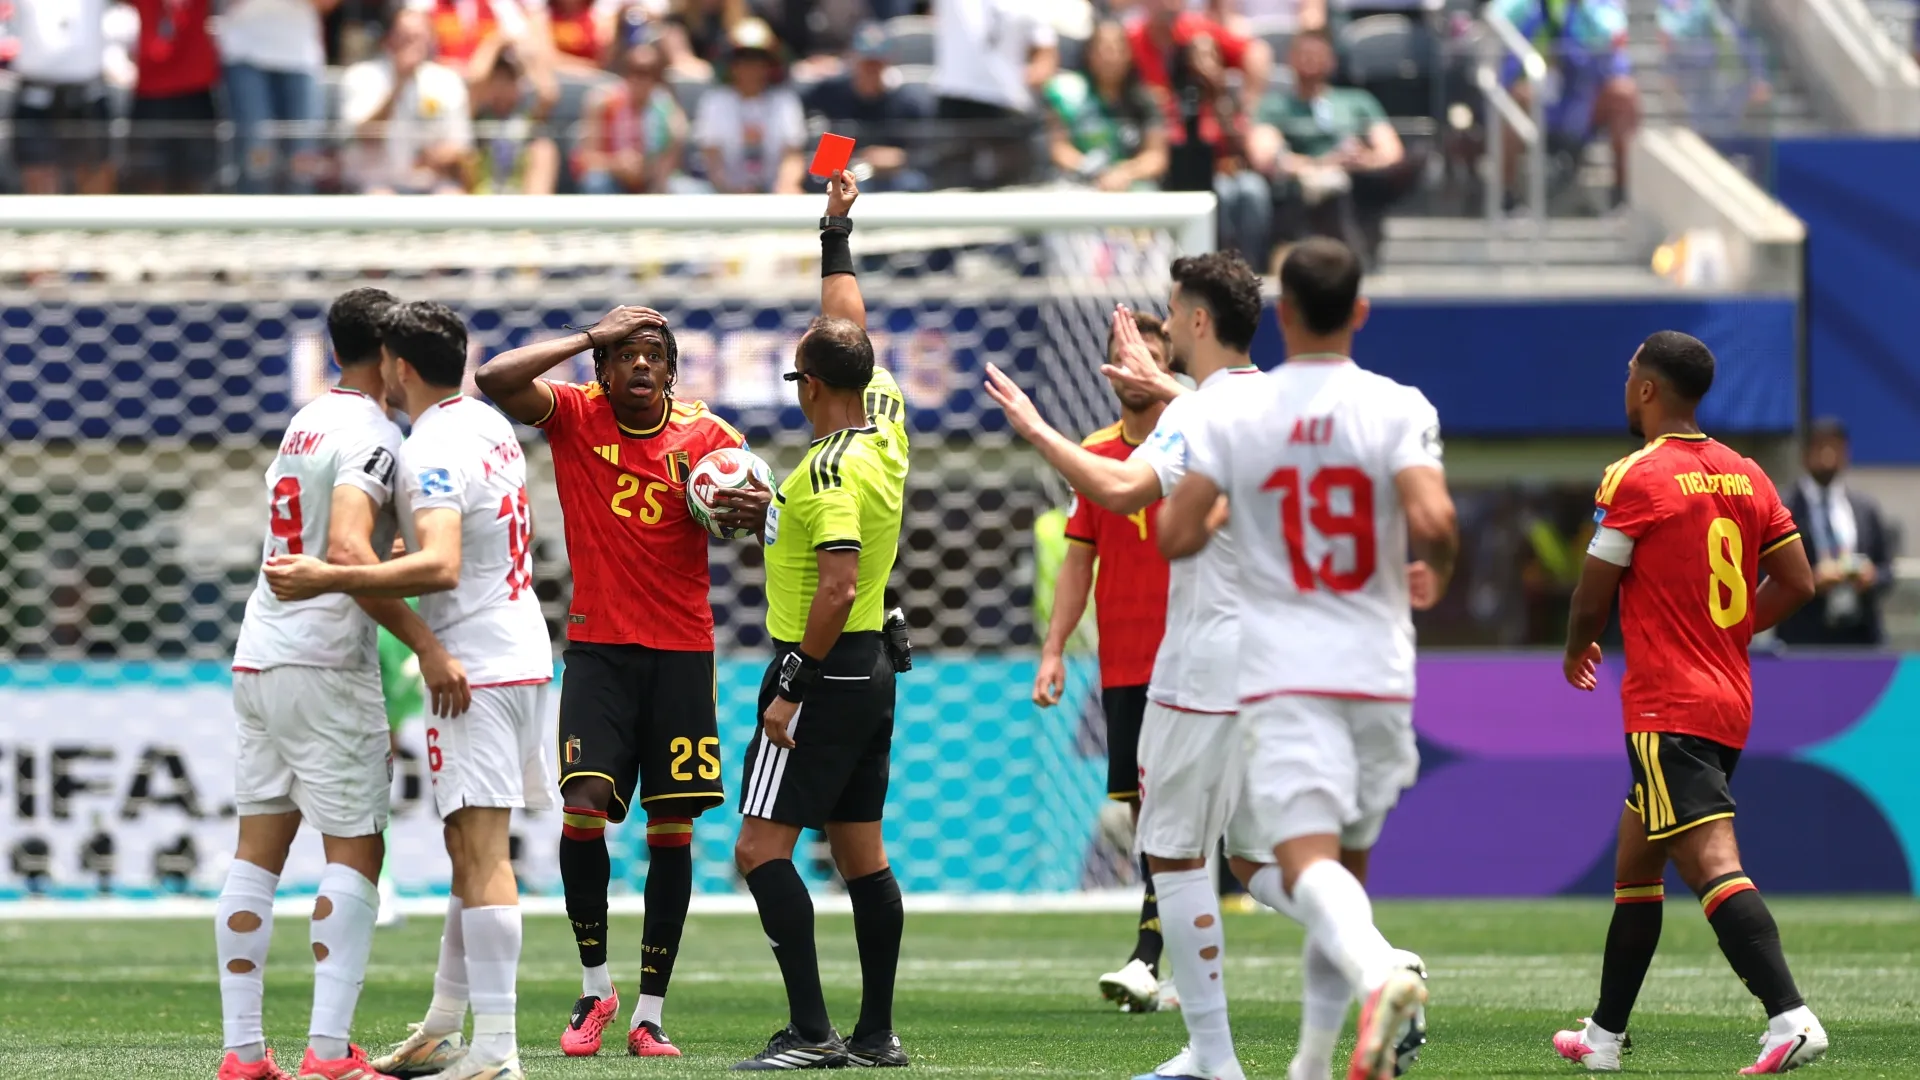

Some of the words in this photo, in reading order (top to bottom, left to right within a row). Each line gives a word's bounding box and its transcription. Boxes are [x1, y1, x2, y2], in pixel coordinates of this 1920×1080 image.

[270, 476, 305, 557] 9
[611, 473, 668, 525] 25
[1258, 465, 1377, 594] 19
[1707, 517, 1748, 630] 8
[670, 737, 721, 781] 25
